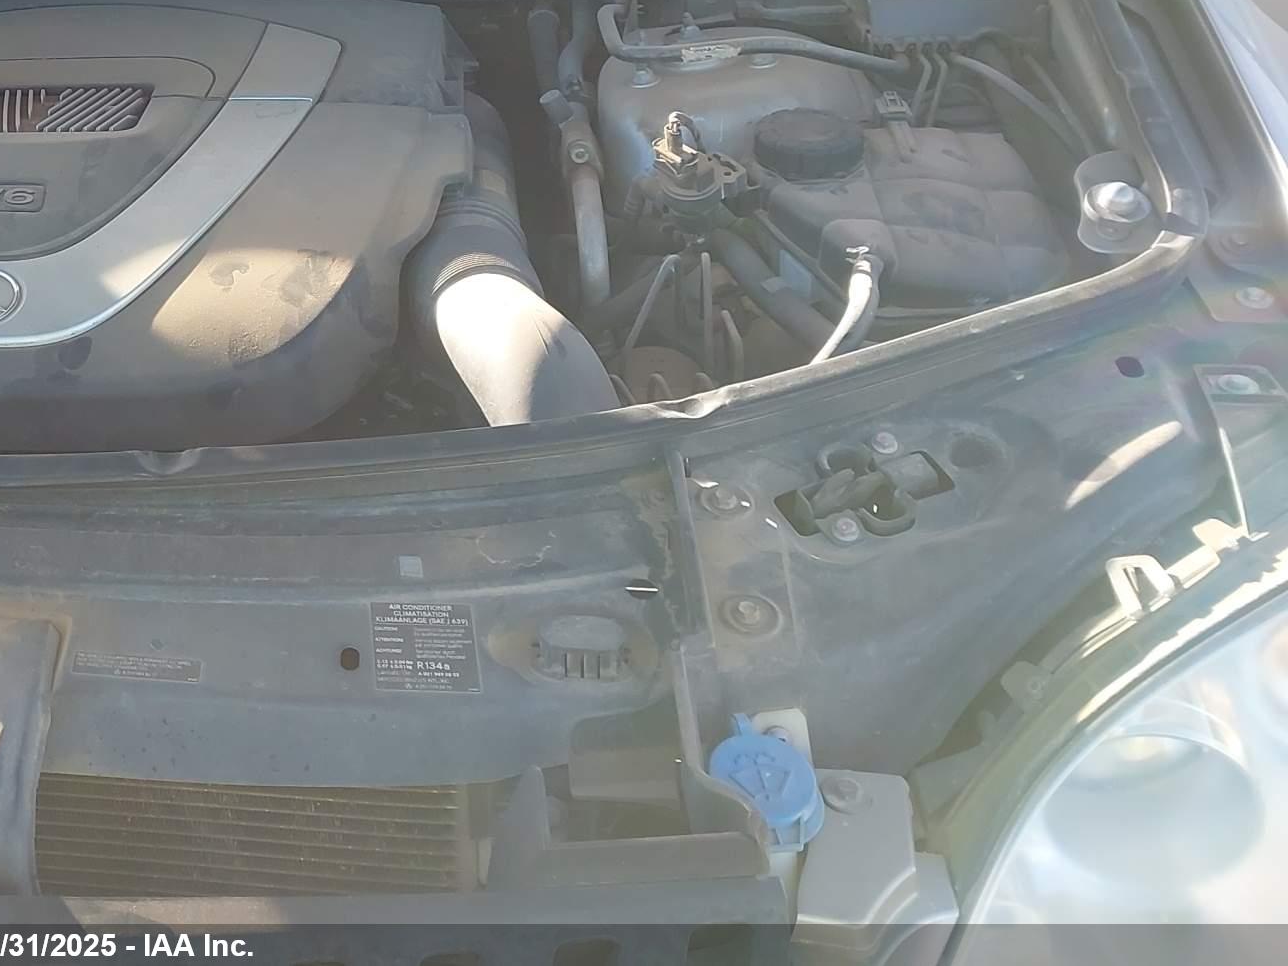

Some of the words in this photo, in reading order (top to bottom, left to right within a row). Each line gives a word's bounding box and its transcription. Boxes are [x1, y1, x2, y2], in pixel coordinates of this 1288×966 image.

[394, 610, 449, 618] CLIMATISATION
[375, 616, 428, 624] KLIMAANLAGE
[416, 661, 450, 670] R134a
